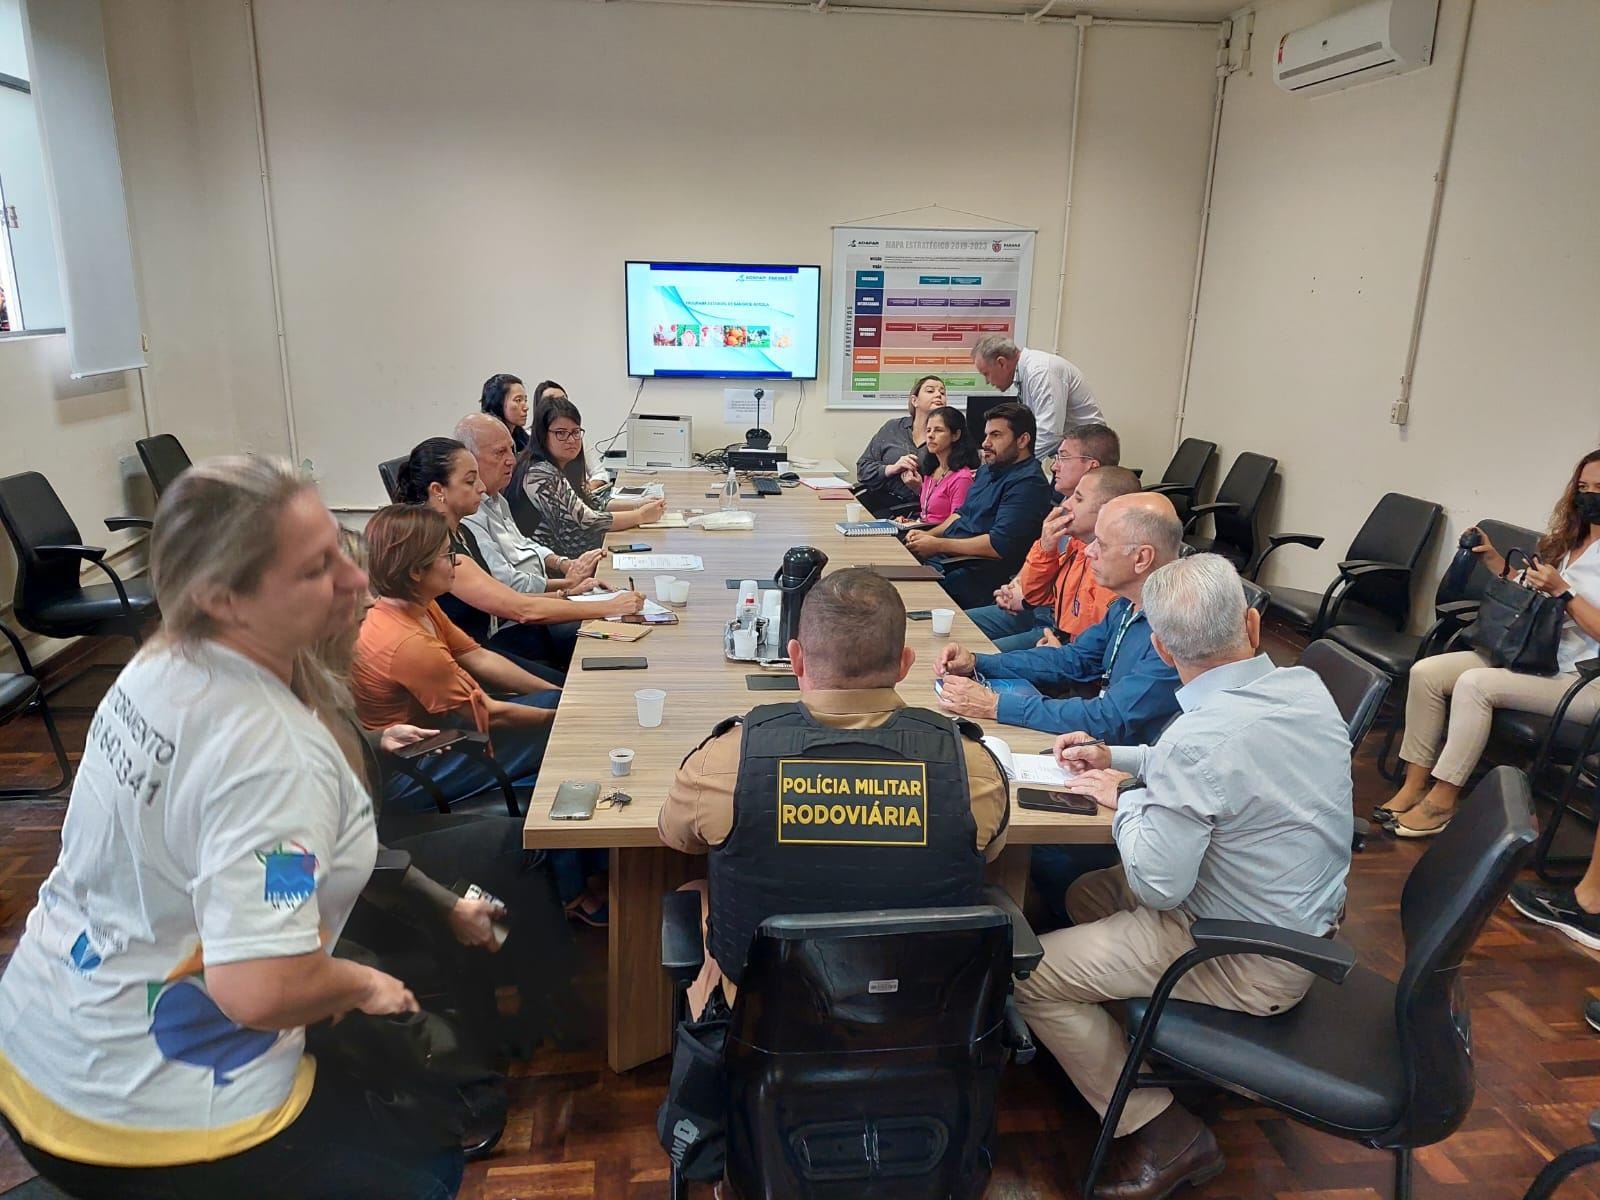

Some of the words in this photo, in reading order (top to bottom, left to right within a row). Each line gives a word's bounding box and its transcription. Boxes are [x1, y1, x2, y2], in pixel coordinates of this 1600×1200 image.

[885, 240, 904, 249] MAPA
[782, 773, 851, 795] POLÍCIA
[855, 778, 922, 796] MILITAR
[782, 800, 922, 827] RODOVIÁRIA
